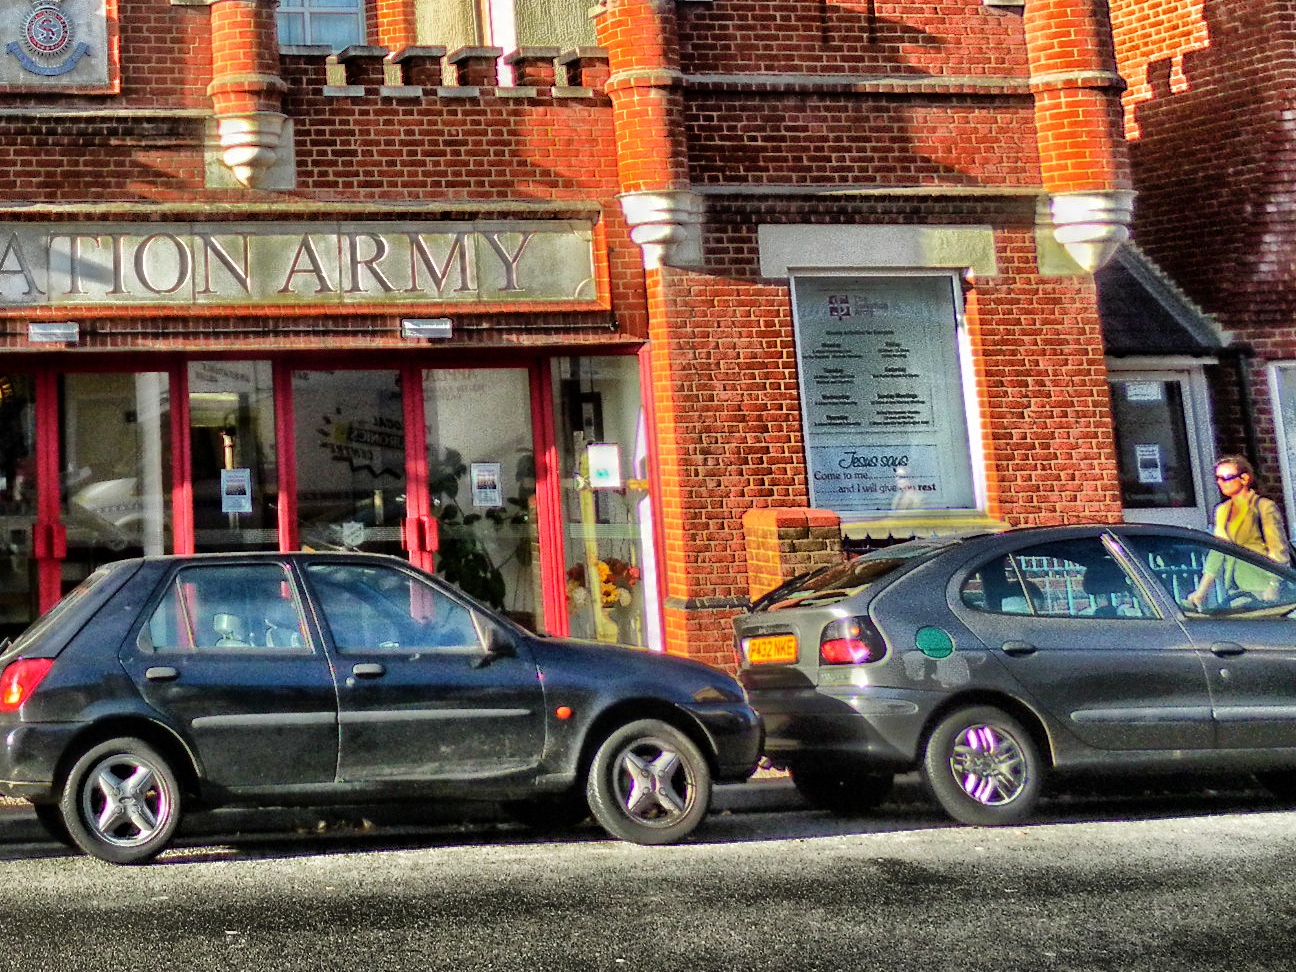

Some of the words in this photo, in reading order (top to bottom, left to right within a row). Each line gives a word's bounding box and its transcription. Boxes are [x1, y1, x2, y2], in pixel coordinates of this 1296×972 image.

[277, 231, 537, 295] ARMY
[838, 451, 878, 468] Jesus
[880, 455, 909, 472] says
[813, 470, 841, 480] Come
[843, 471, 852, 480] to
[862, 483, 878, 493] will
[879, 484, 897, 494] give
[917, 483, 936, 491] rest
[750, 640, 773, 658] P432
[774, 638, 794, 656] NKE
